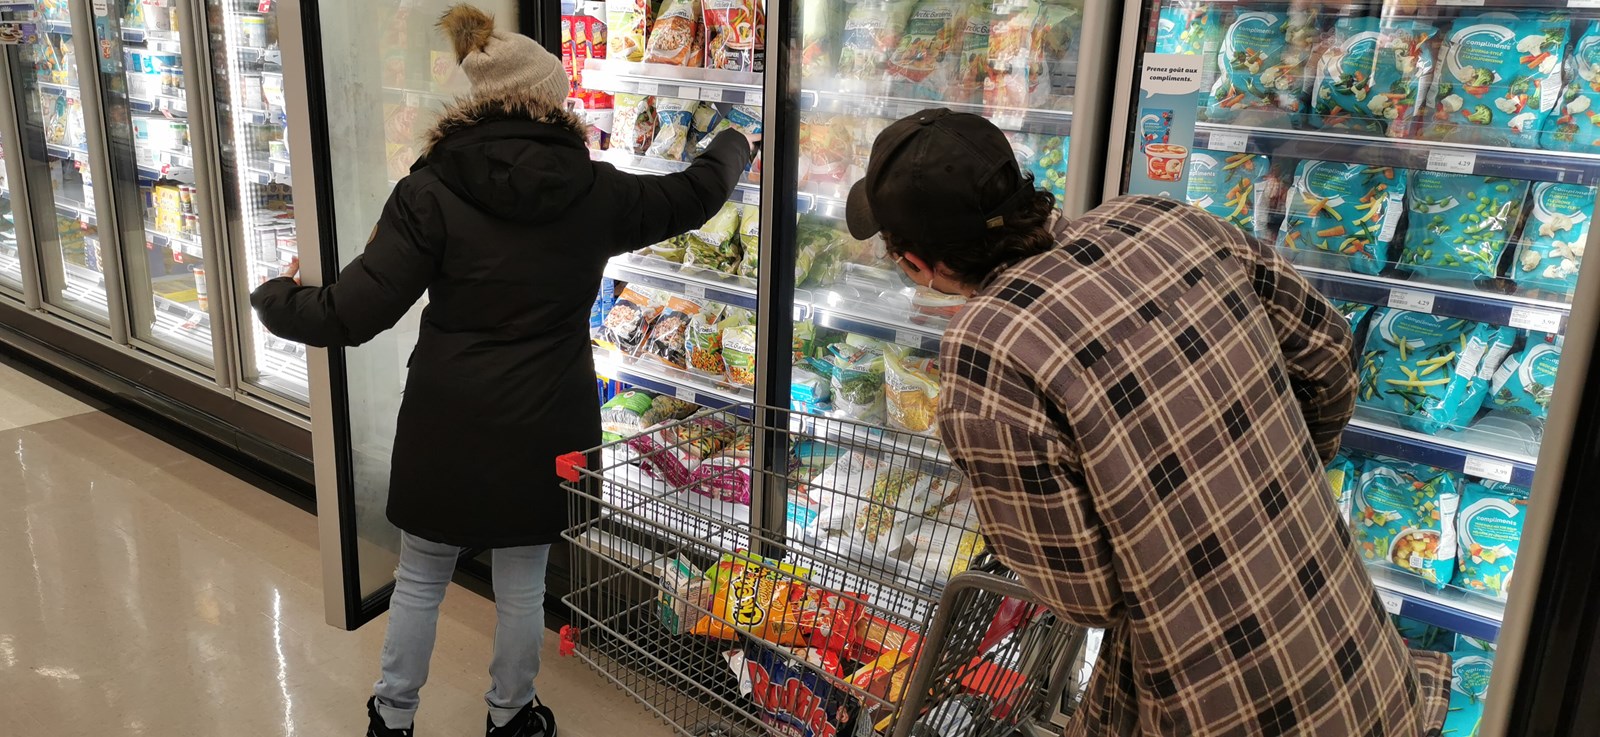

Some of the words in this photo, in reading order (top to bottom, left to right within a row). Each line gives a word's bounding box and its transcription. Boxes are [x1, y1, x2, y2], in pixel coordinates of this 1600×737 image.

[1238, 26, 1275, 34] compliments
[1466, 40, 1511, 50] compliments
[1499, 484, 1529, 496] complime
[1476, 516, 1517, 526] compliments
